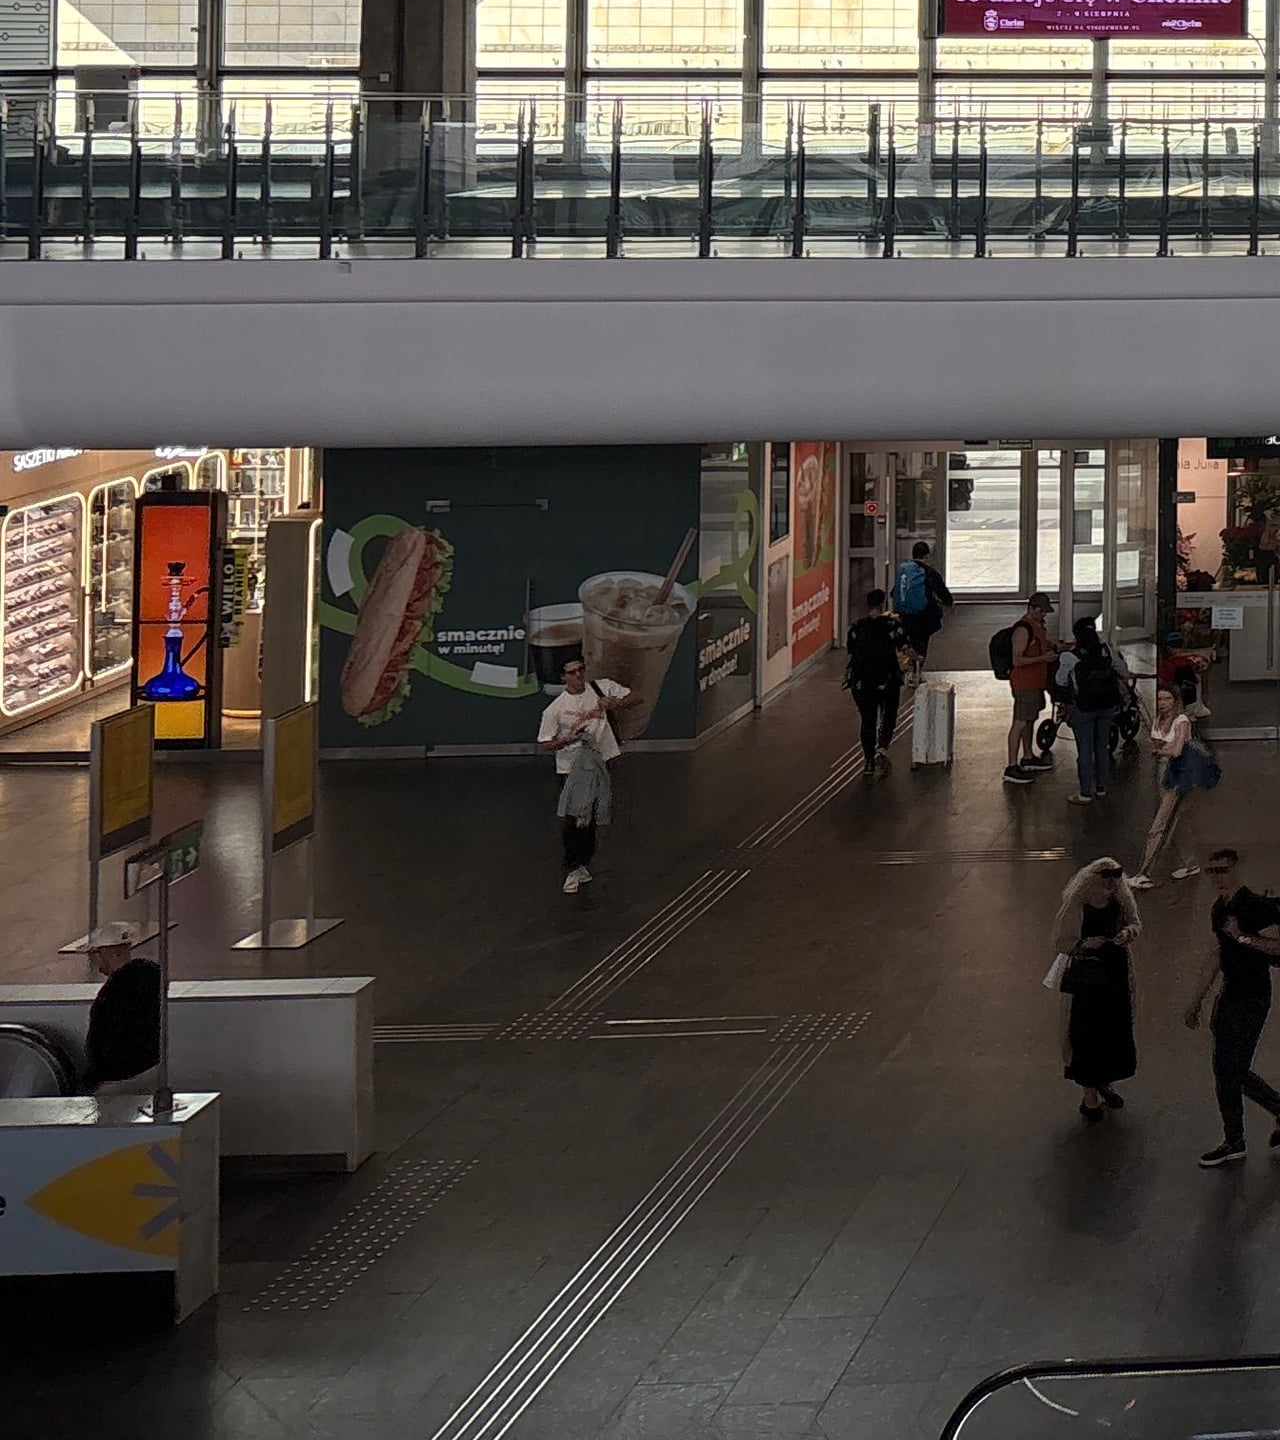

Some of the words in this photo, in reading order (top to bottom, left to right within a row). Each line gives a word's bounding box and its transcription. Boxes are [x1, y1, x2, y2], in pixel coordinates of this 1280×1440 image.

[437, 625, 526, 642] smacznie
[438, 645, 450, 655] w
[453, 643, 505, 656] minutę!
[699, 617, 750, 669] smacznie
[699, 675, 707, 692] w
